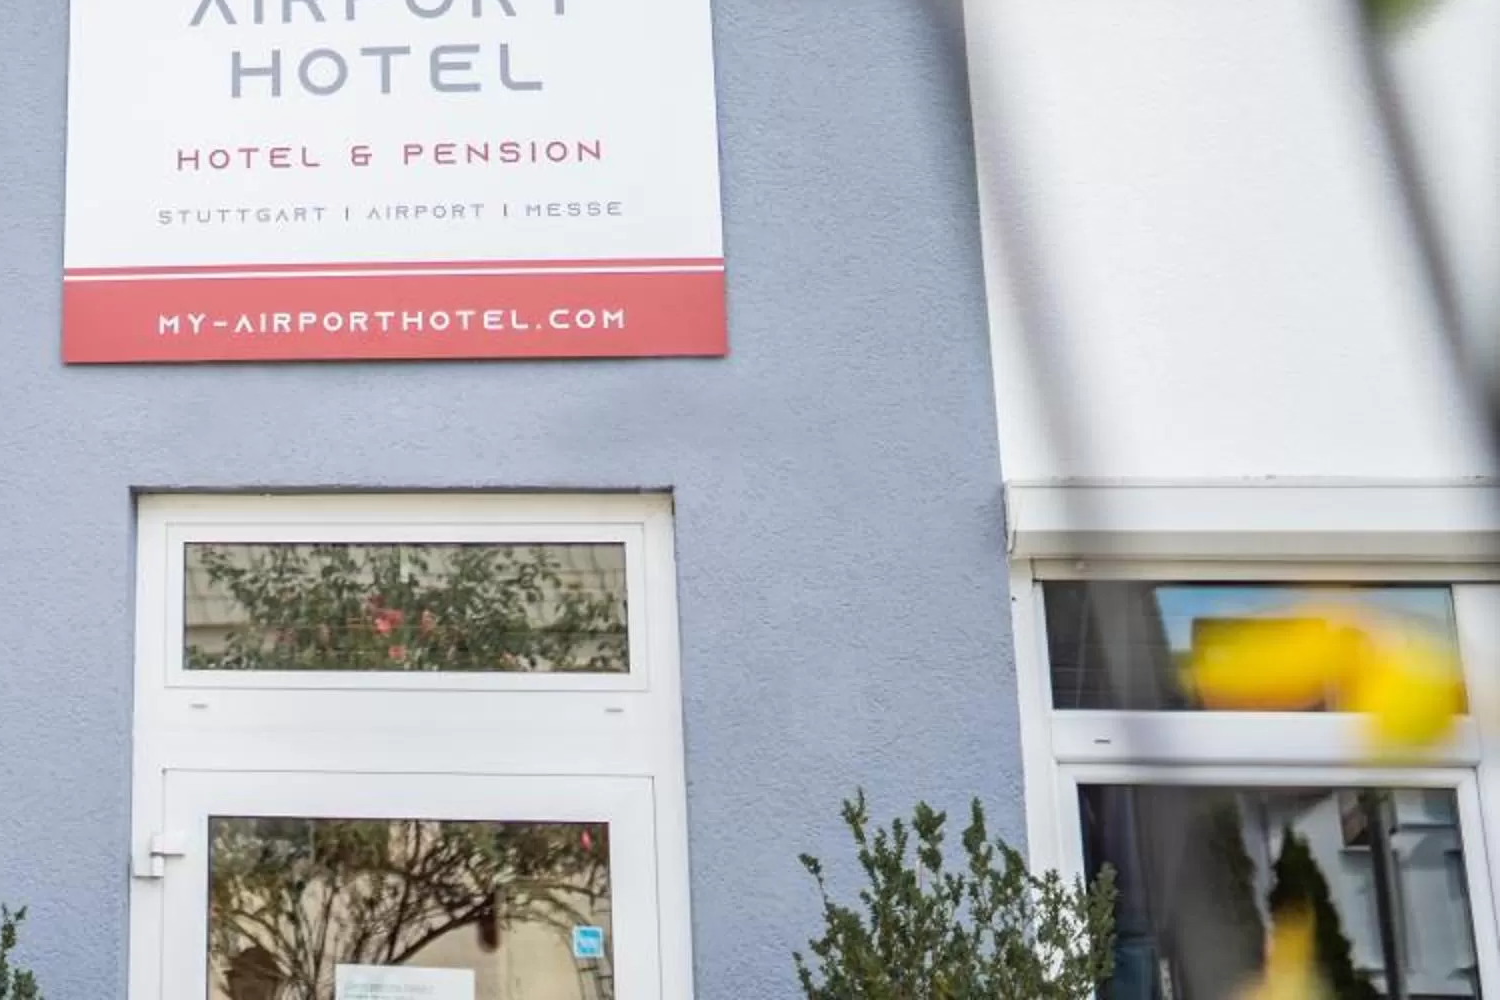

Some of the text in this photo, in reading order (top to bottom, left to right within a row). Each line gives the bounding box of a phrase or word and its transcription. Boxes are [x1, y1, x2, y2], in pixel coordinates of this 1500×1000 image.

[231, 42, 544, 99] HOTEL
[177, 139, 601, 171] HOTEL & PENSION
[158, 206, 326, 226] STUTTGART
[367, 203, 486, 221] AIRPORT
[525, 200, 624, 218] MESSE
[158, 308, 625, 335] MY-AIRPORTHOTEL.COM
